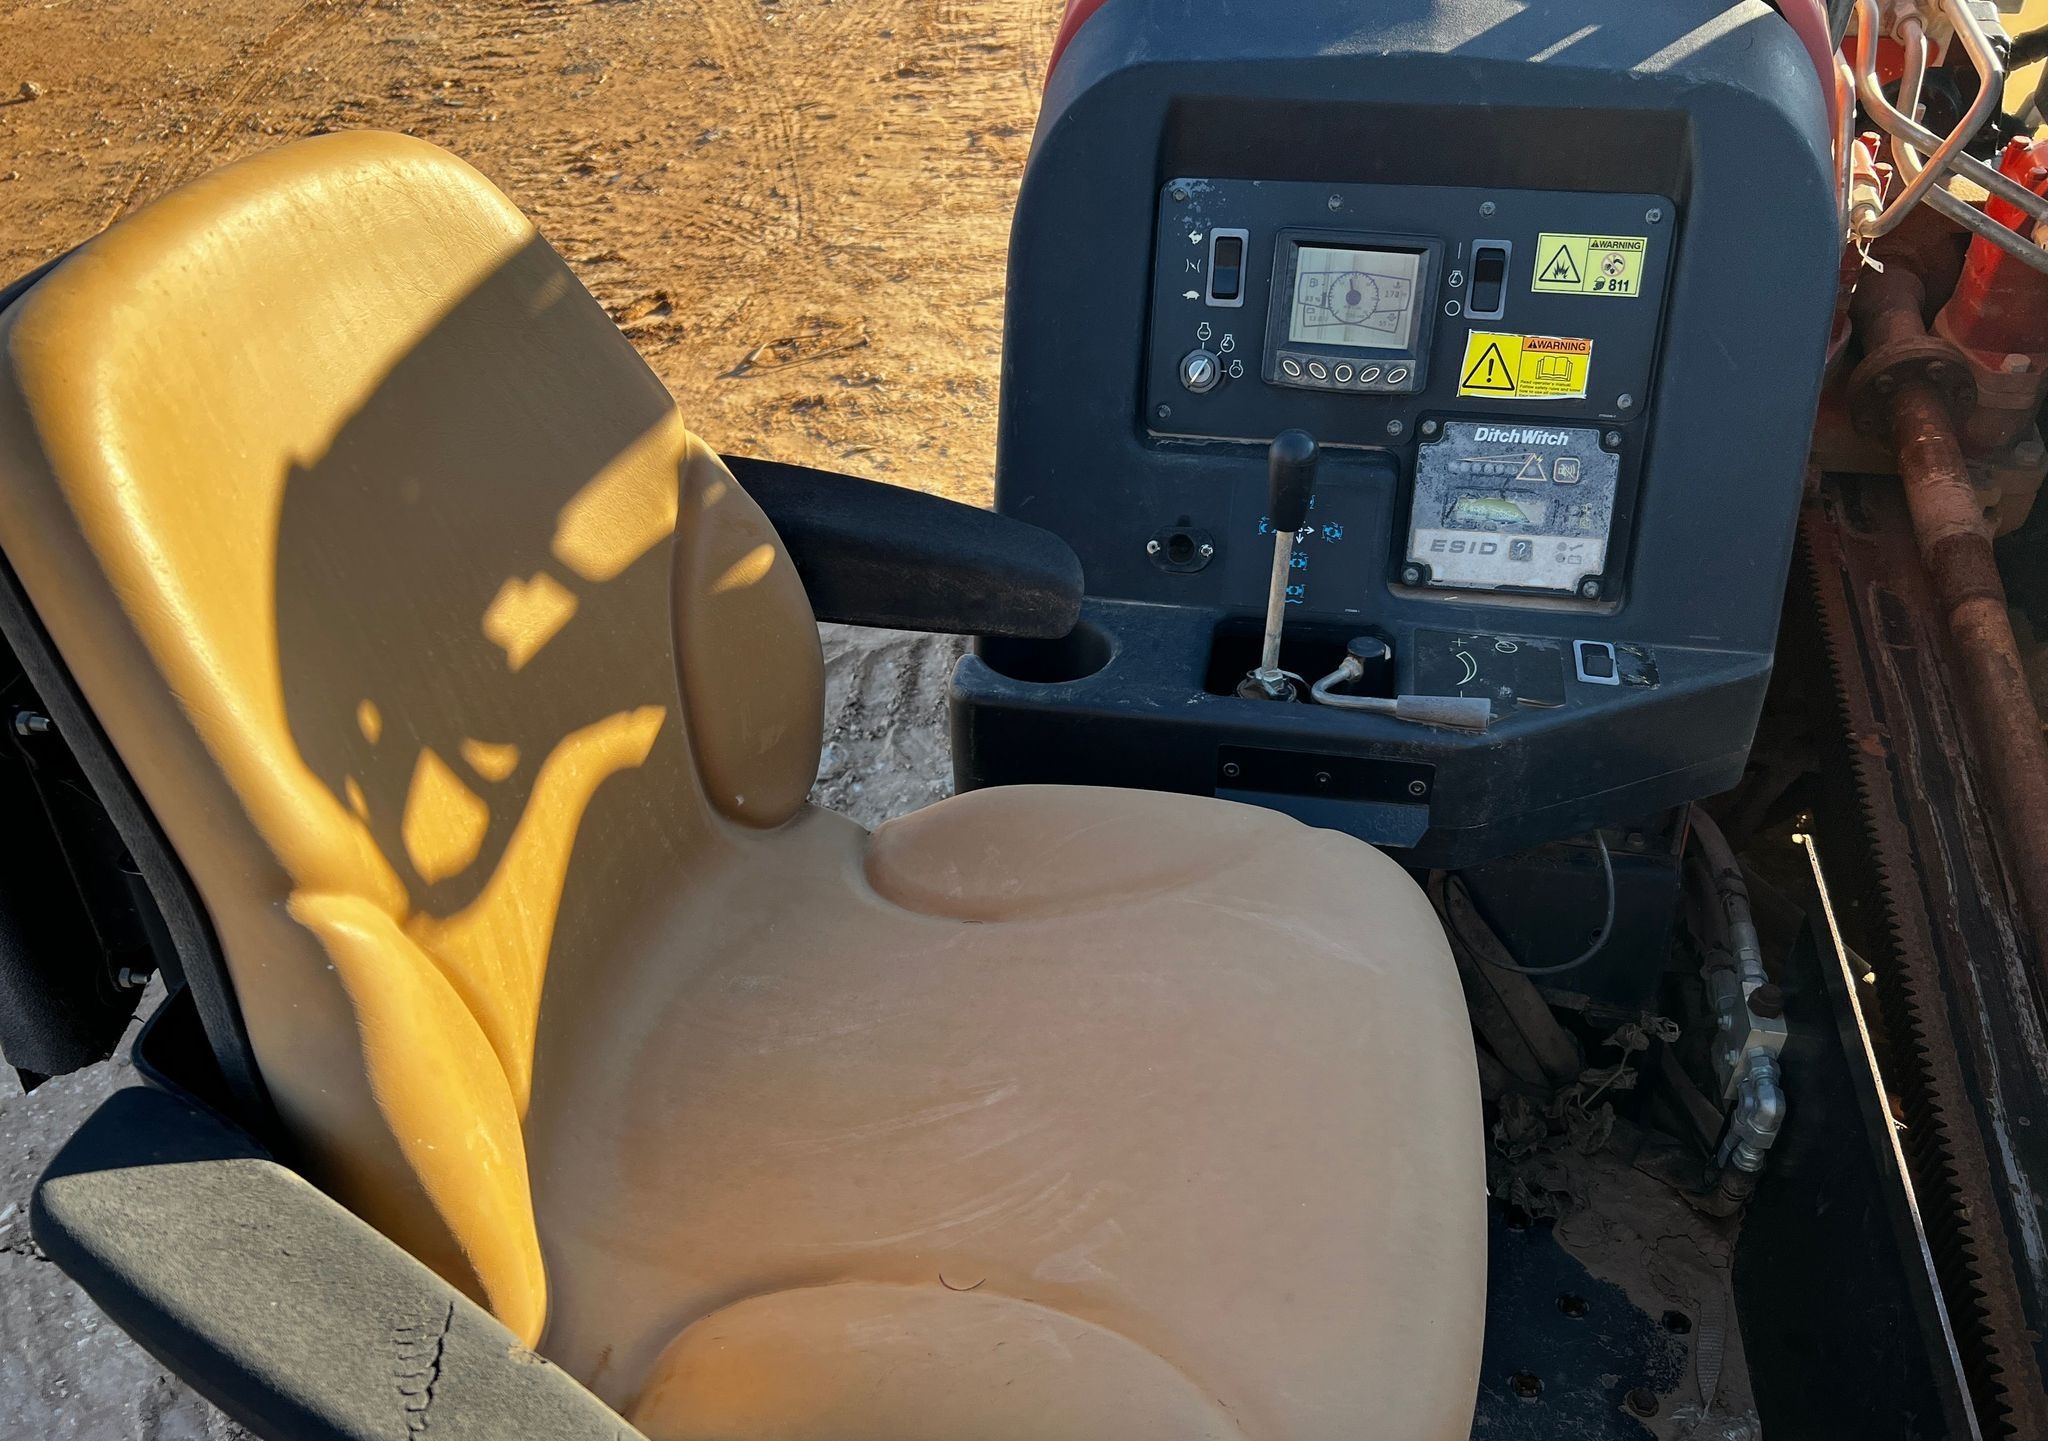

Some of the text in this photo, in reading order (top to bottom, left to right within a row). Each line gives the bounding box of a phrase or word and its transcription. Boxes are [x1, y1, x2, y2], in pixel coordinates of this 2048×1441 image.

[1600, 241, 1641, 250] WARNING
[1608, 279, 1630, 292] 811
[1537, 340, 1586, 351] WARNING
[1430, 539, 1498, 555] ESID
